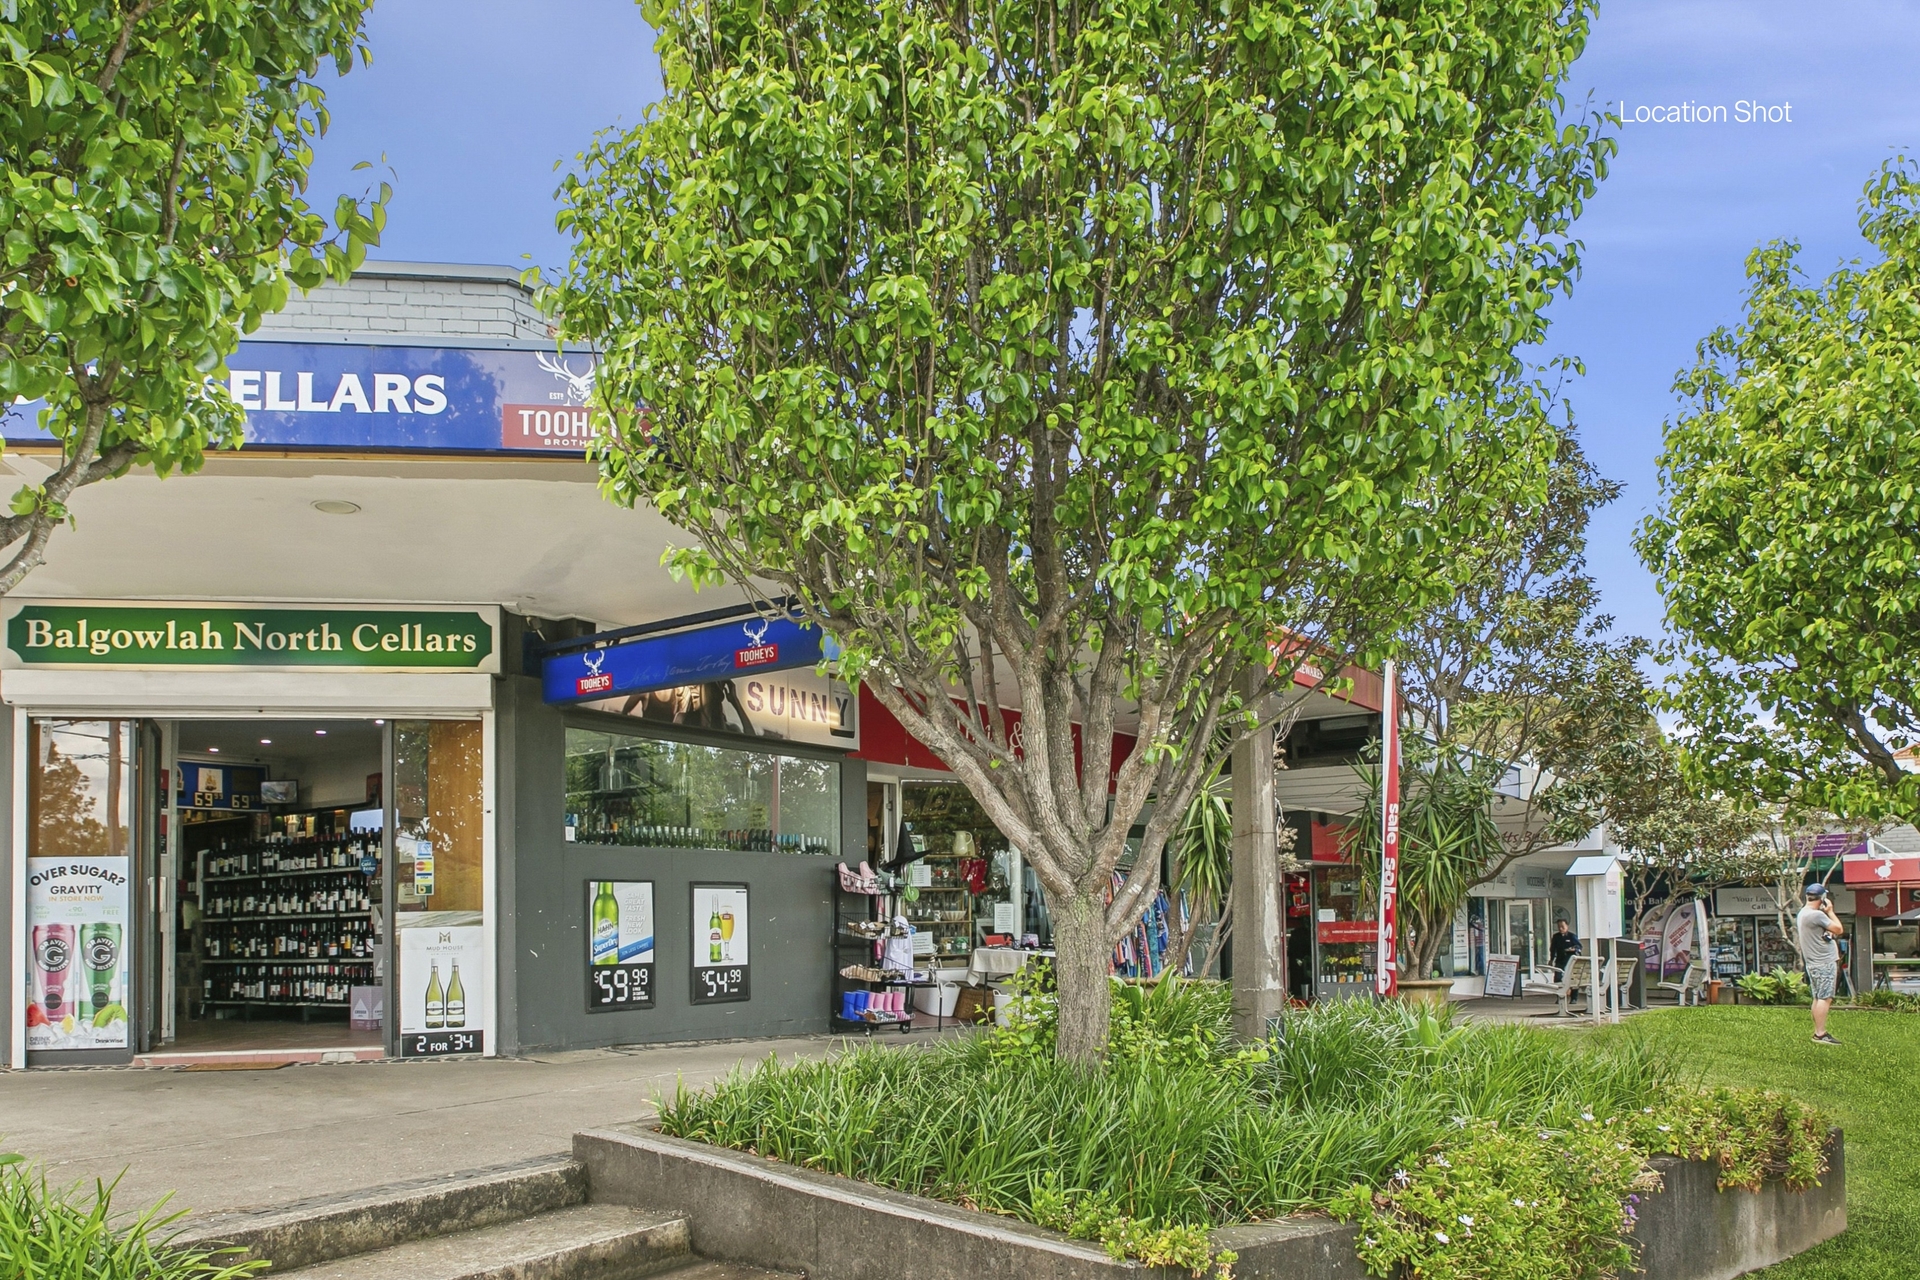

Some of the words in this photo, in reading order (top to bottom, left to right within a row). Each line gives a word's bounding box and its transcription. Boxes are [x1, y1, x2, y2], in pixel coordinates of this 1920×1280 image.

[204, 369, 448, 415] ELLARS
[518, 409, 618, 438] TOOHY
[25, 618, 224, 655] Balgowlah
[233, 622, 343, 651] North
[352, 623, 477, 652] Cellars
[739, 648, 775, 663] TOOHEYS
[580, 676, 610, 690] TOOHEYS
[747, 681, 849, 727] SUNNY
[1387, 803, 1399, 844] sale
[30, 866, 67, 886] OVER
[70, 865, 126, 886] SUGAR?
[1384, 858, 1397, 910] sale
[50, 885, 102, 894] GRAVITY
[39, 939, 69, 951] GRAVITY
[86, 938, 116, 950] GRAVITY
[1384, 927, 1397, 992] sale
[416, 1035, 427, 1052] 2
[430, 1042, 448, 1052] FOR
[449, 1034, 473, 1051] $34
